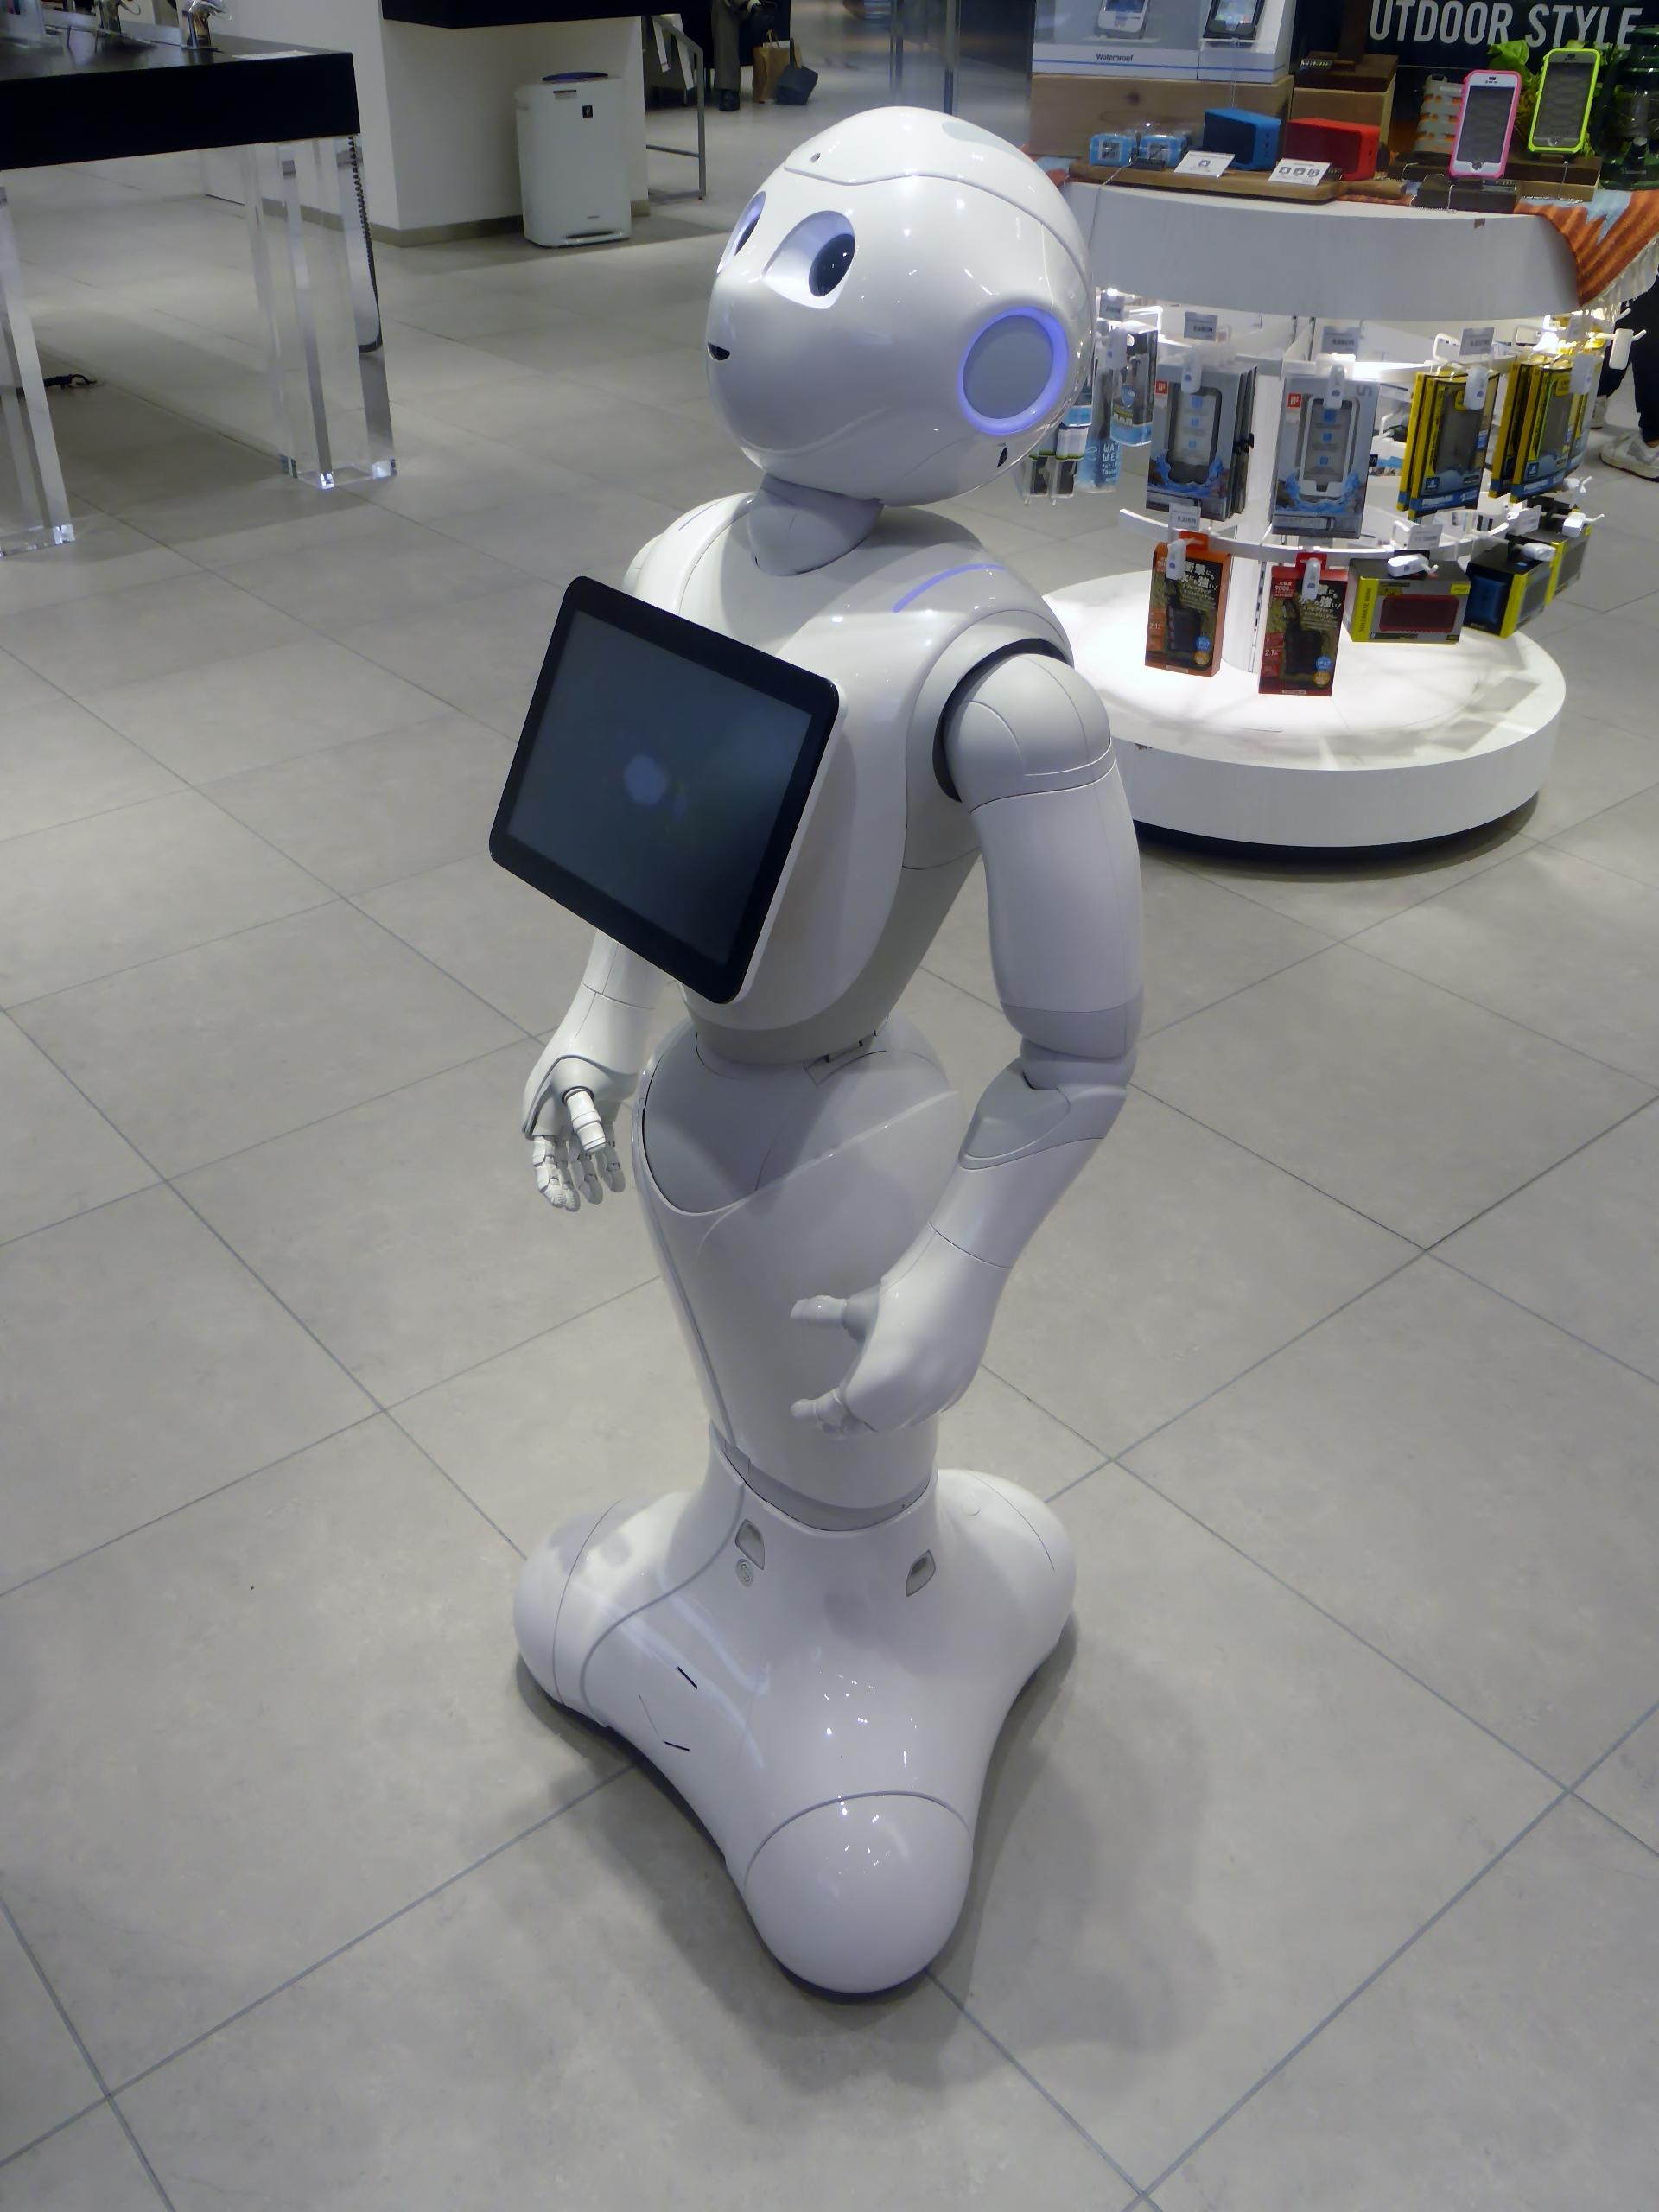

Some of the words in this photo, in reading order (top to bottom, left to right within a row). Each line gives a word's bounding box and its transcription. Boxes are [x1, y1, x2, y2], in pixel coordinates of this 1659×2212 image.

[1370, 0, 1513, 45] UTDOOR
[1525, 3, 1643, 50] STYLE
[1096, 53, 1134, 62] Waterproof
